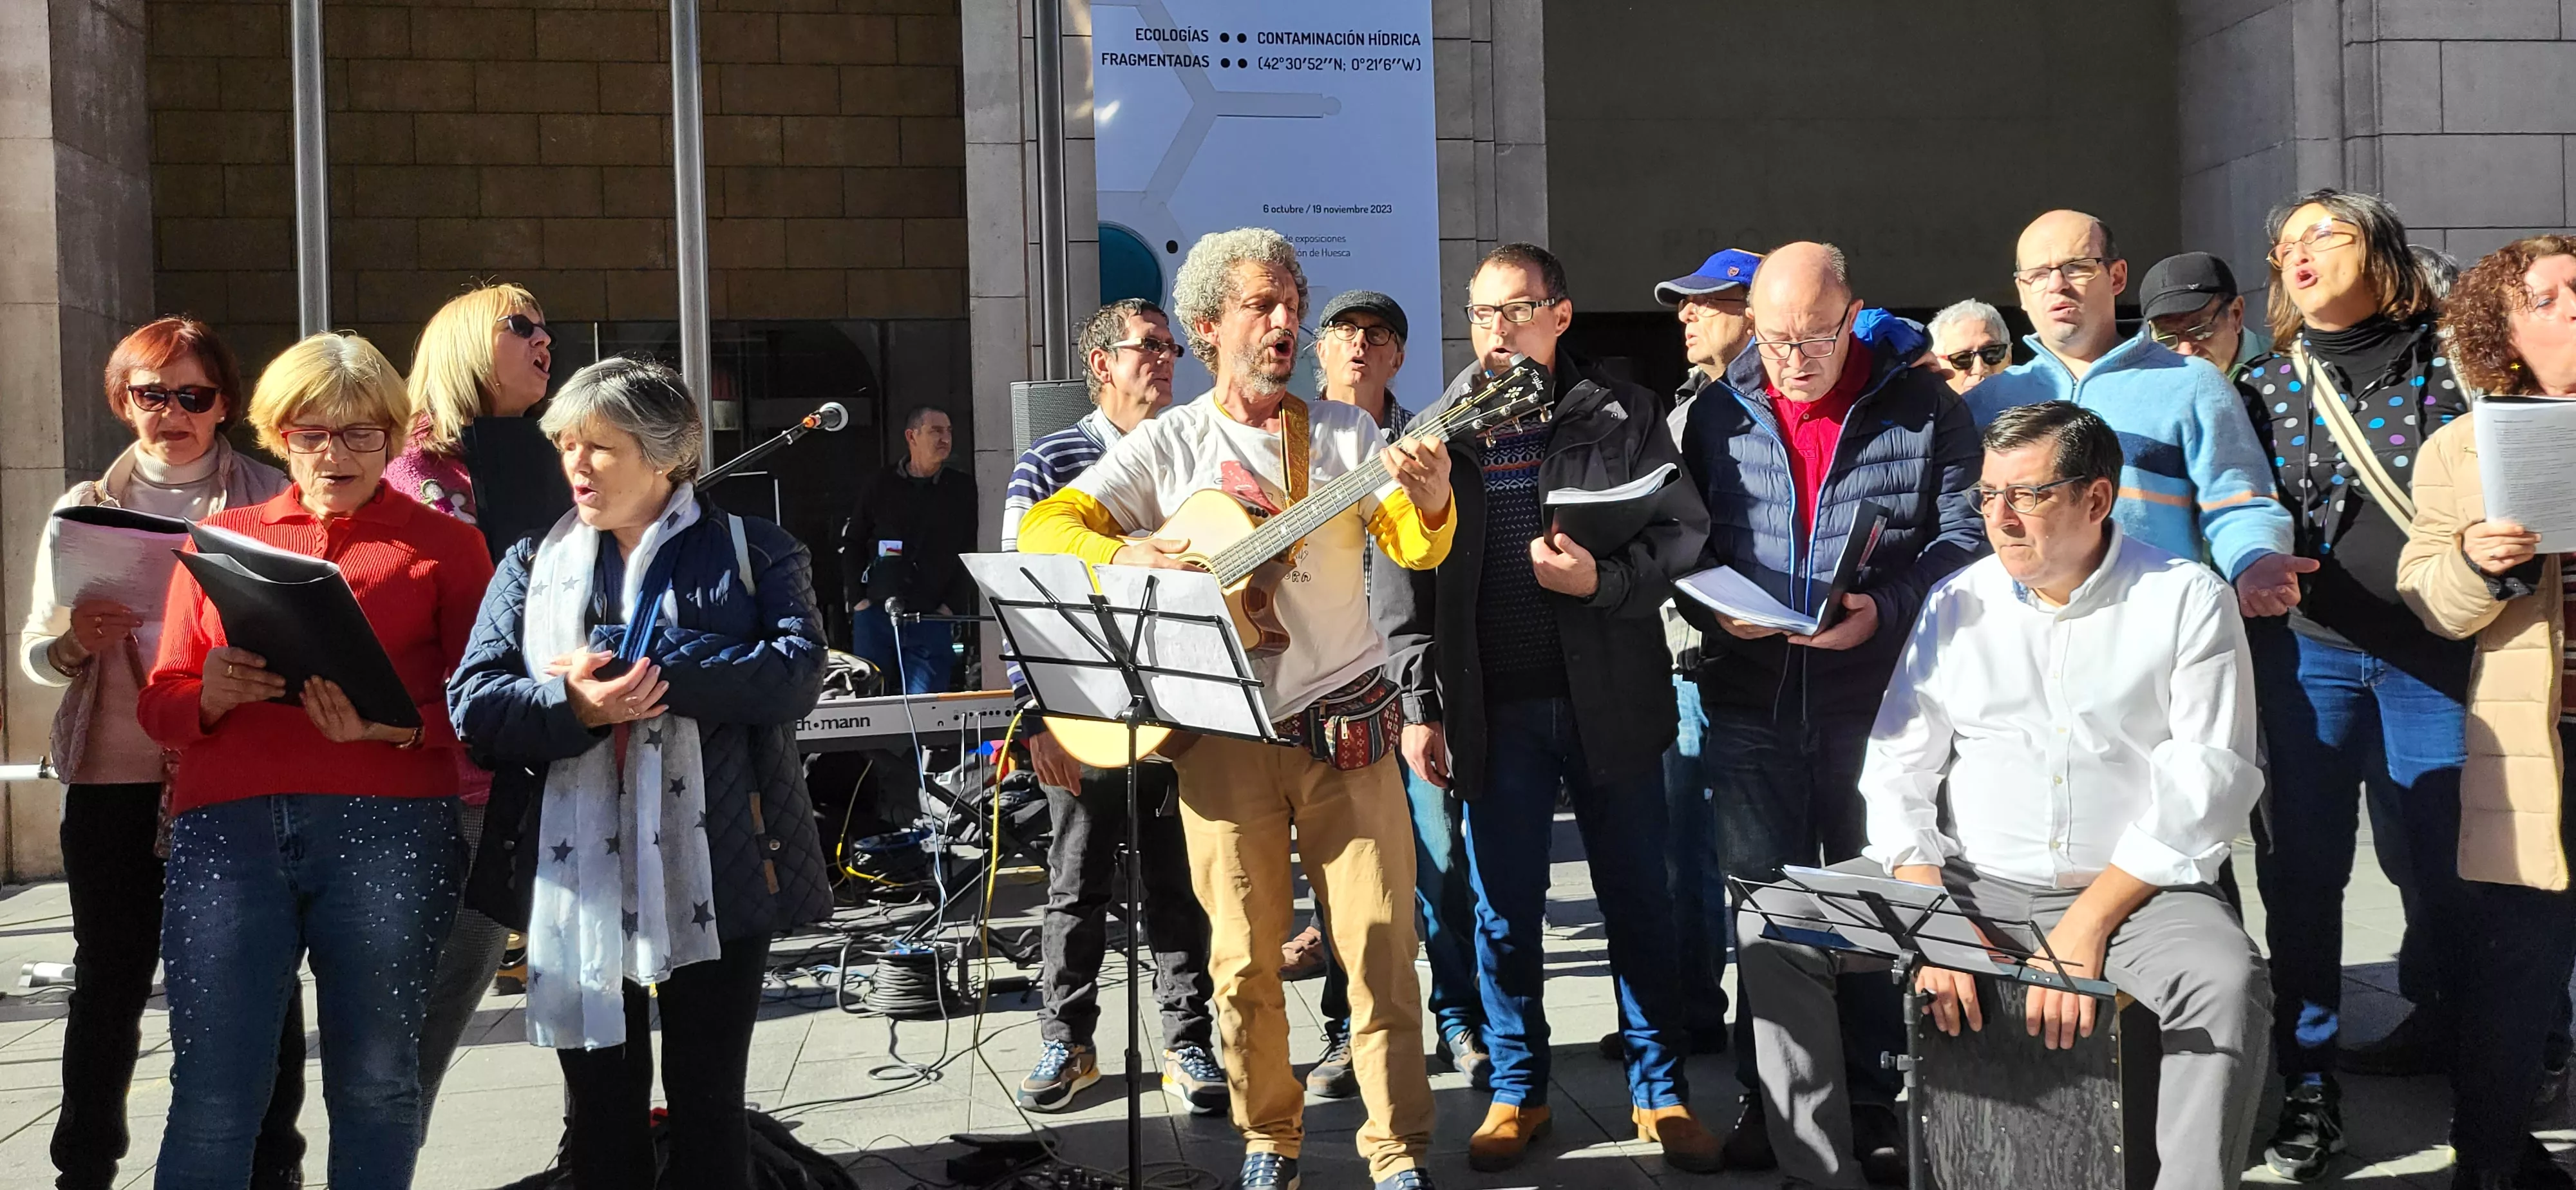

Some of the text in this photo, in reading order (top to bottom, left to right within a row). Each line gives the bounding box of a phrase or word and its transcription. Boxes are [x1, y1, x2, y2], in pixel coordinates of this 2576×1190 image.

[1135, 26, 1209, 42] ECOLOGÍAS
[1257, 30, 1421, 46] CONTAMINACIÓN HÍDRICA
[1101, 53, 1210, 68] FRAGMENTADAS
[1263, 204, 1392, 214] 6 octubre / 19 noviembre 2023
[1295, 235, 1347, 245] exposiciones
[1309, 249, 1320, 257] de
[1321, 249, 1350, 257] Huesca
